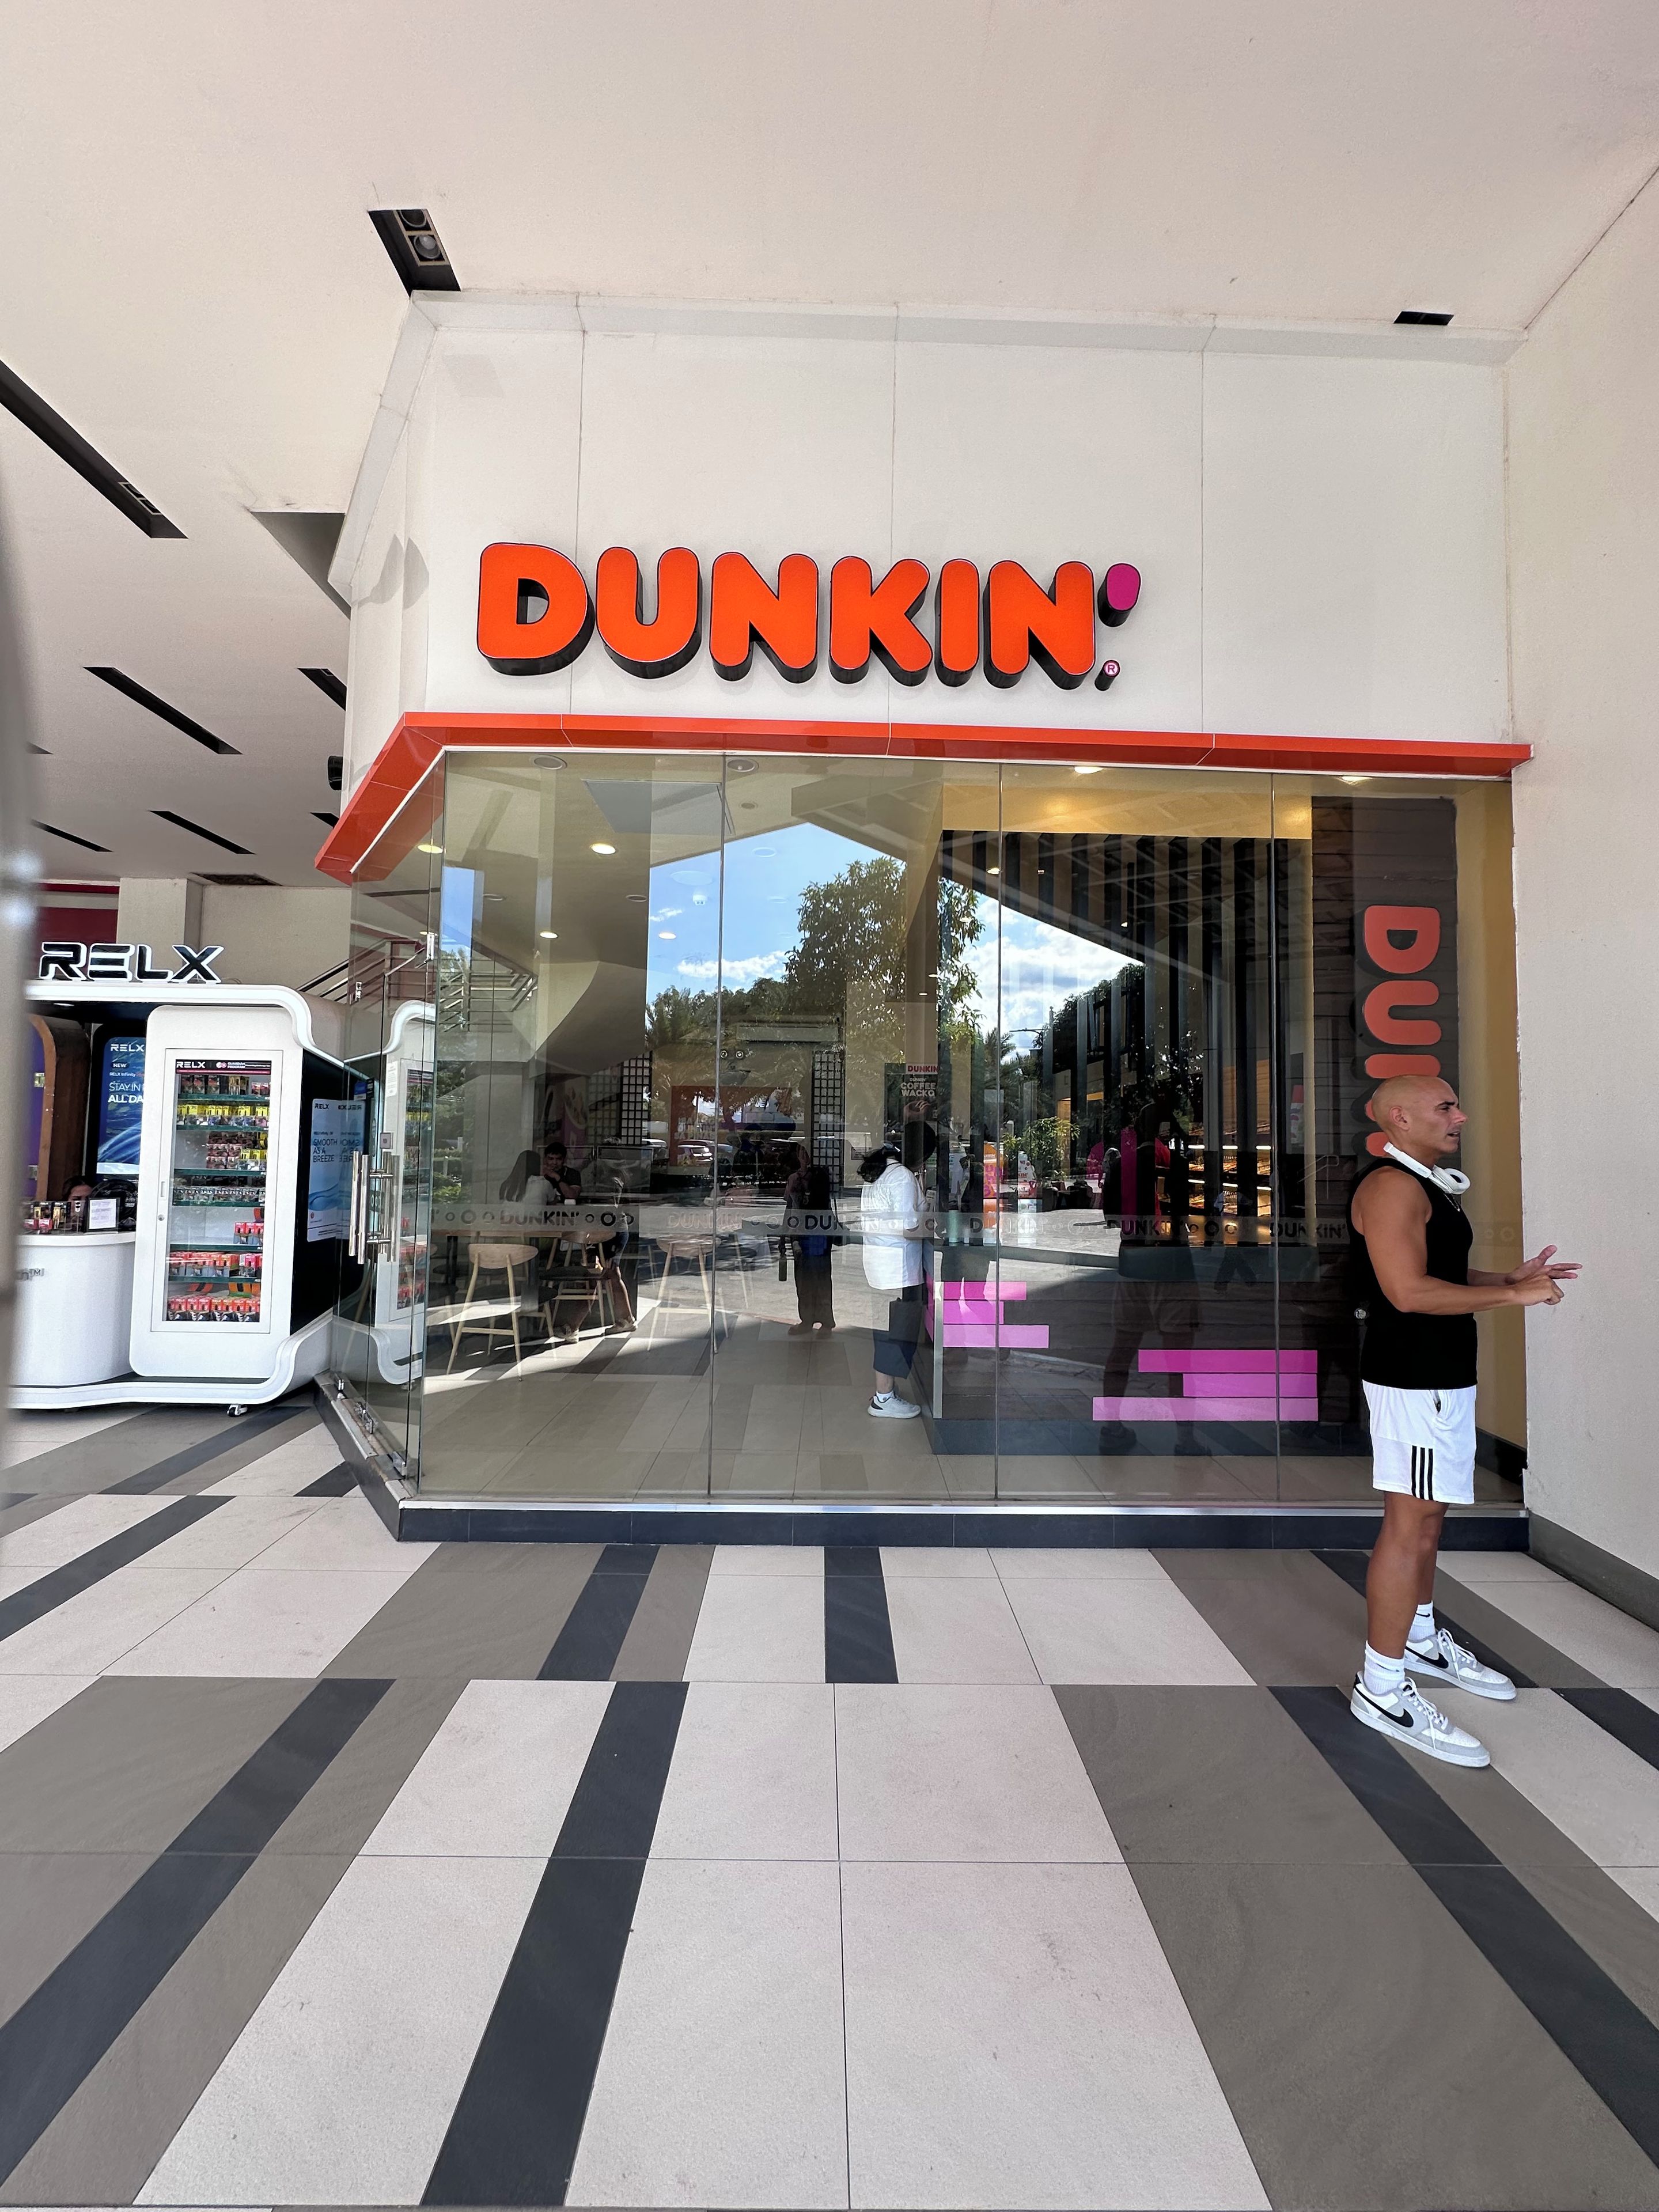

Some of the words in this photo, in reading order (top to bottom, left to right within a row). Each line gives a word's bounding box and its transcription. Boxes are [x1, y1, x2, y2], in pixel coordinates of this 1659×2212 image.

[477, 542, 1141, 688] DUNKIN'
[39, 942, 224, 983] RELX
[111, 1044, 145, 1052] RELX
[109, 1083, 131, 1092] STAY
[131, 1084, 141, 1092] IN
[108, 1094, 127, 1103] ALL
[313, 1138, 337, 1146] SMOOTH
[313, 1154, 335, 1162] BREEZE
